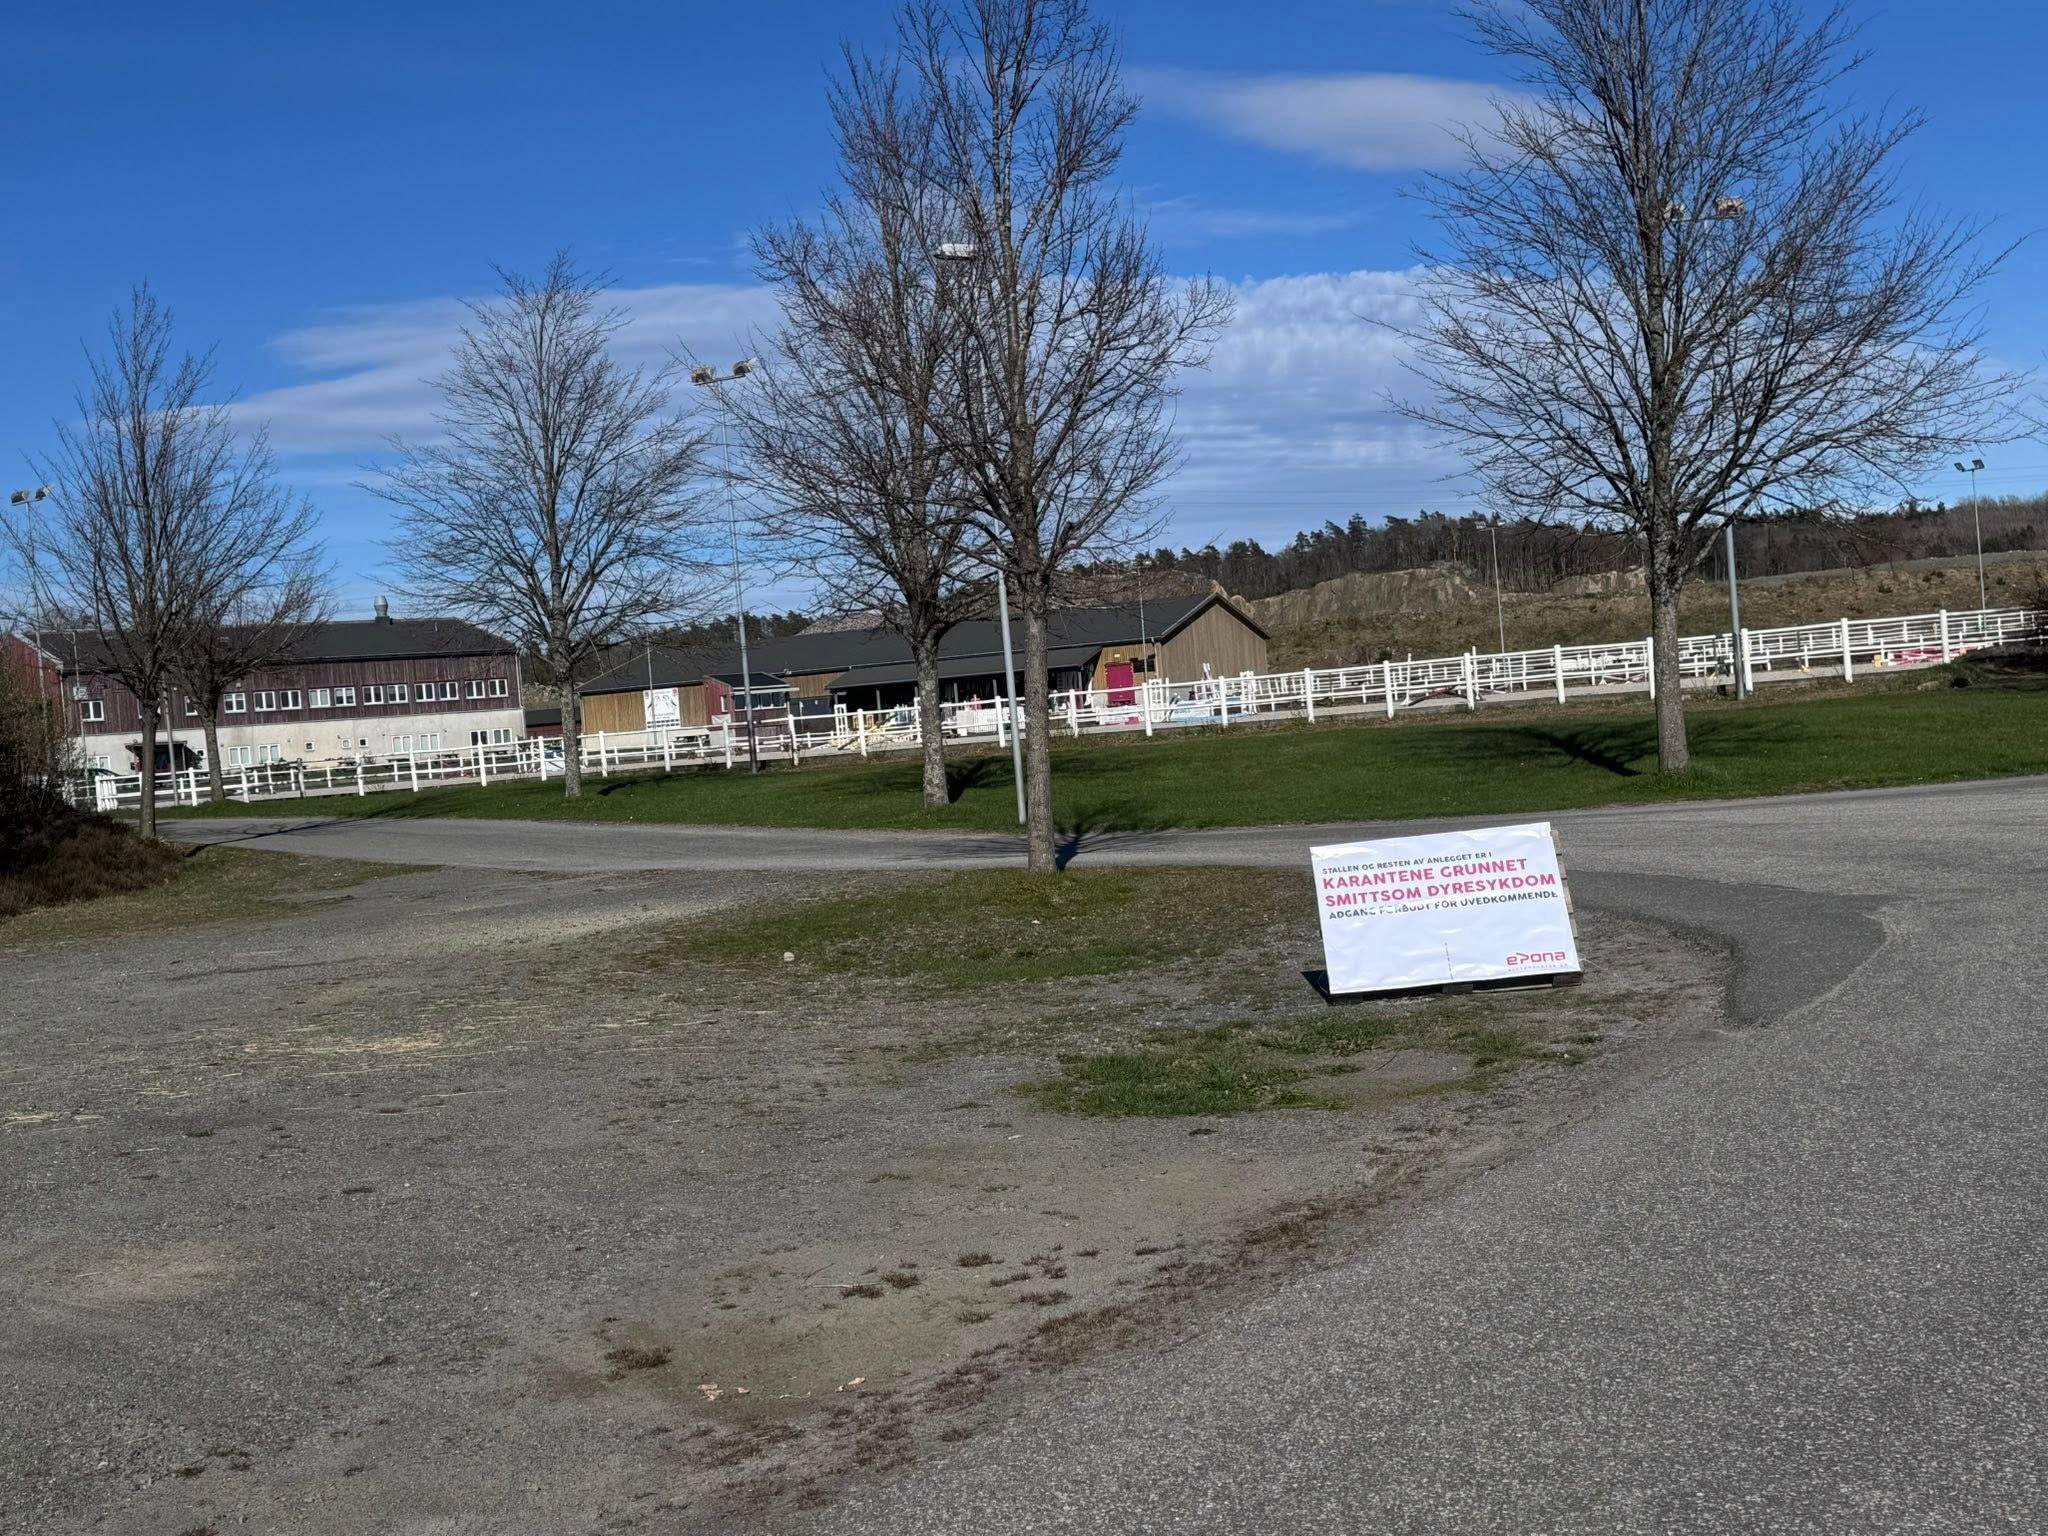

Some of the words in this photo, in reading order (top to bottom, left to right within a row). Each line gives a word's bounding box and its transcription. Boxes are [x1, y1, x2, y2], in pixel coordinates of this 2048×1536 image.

[1322, 865, 1359, 875] STALLEN
[1361, 863, 1375, 871] OG
[1376, 860, 1411, 869] RESTEN
[1427, 853, 1472, 864] ANLEGGET
[1323, 868, 1435, 889] KARANTENE
[1440, 858, 1527, 878] GRUNNET
[1325, 887, 1421, 907] SMITTSOM
[1427, 873, 1556, 897] DYRESYKDOM
[1434, 900, 1458, 909] FOR
[1460, 890, 1558, 906] UVEDKOMMENDE
